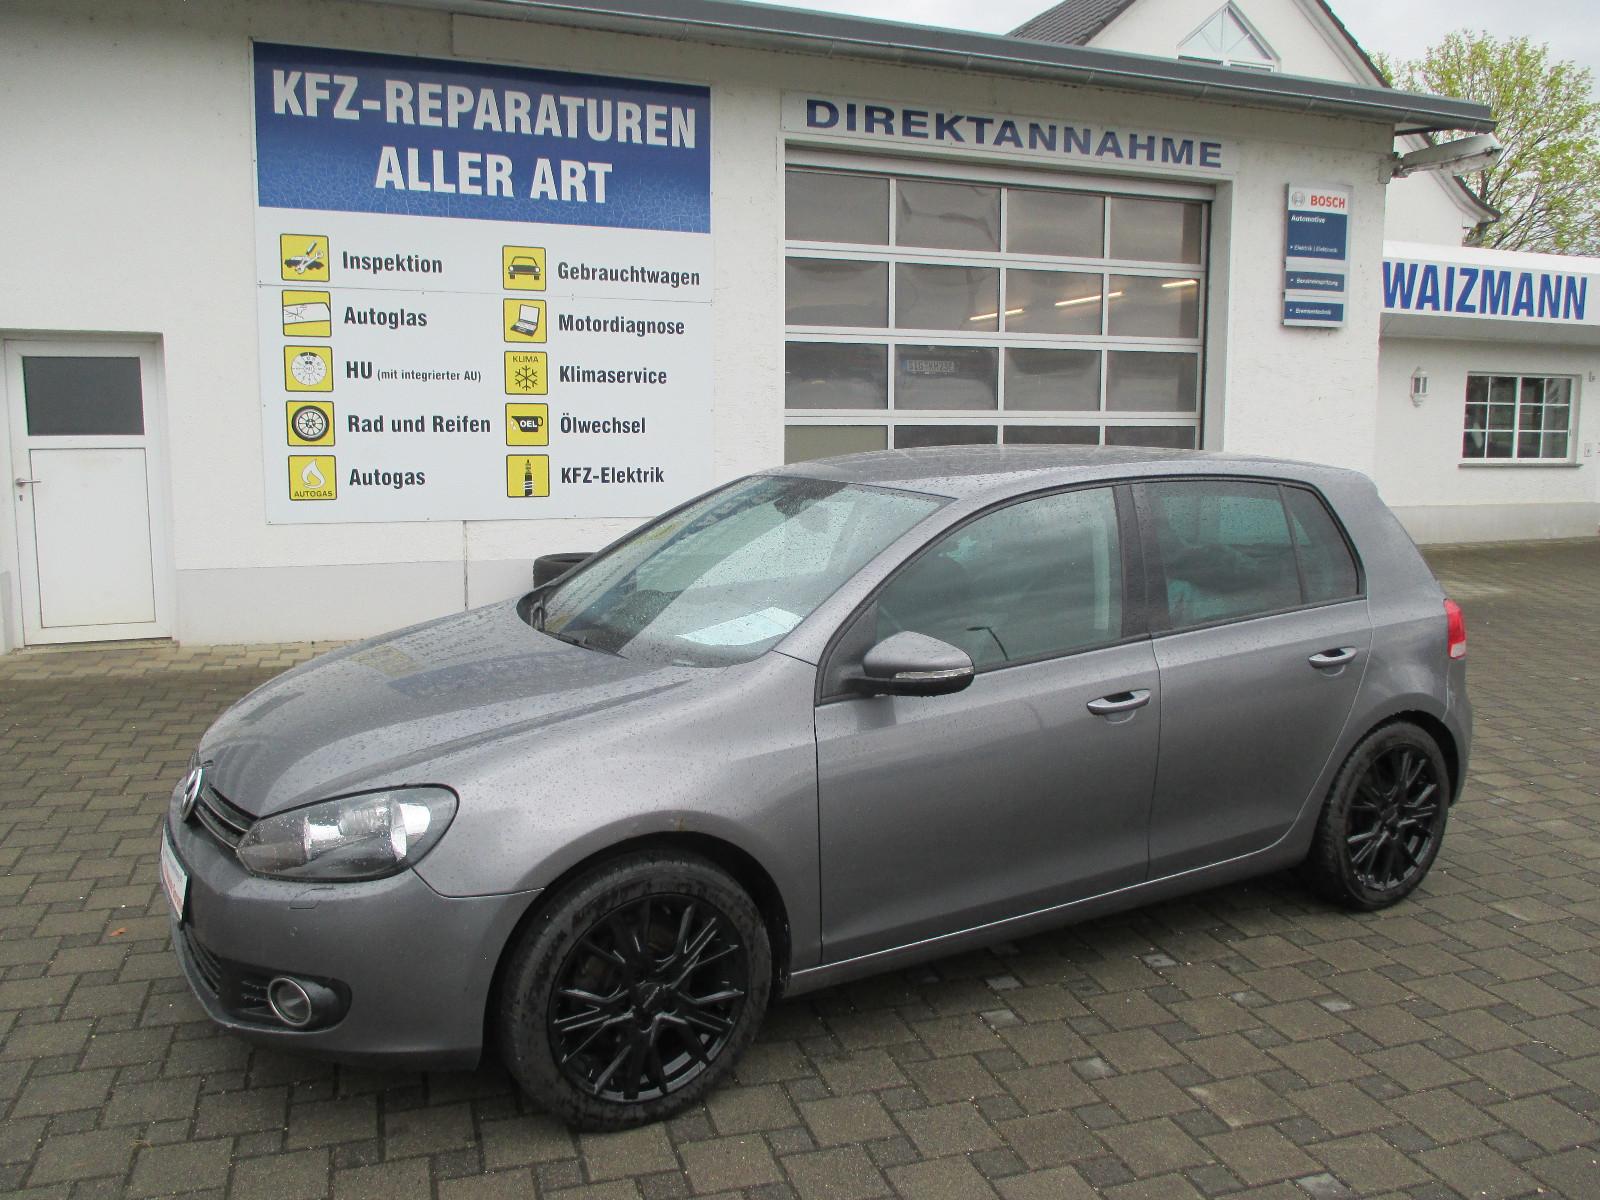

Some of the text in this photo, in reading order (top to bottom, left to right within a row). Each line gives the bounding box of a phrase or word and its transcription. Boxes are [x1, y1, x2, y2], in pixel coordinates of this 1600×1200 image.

[273, 69, 696, 149] KFZ-REPARATUREN
[807, 99, 1222, 168] DIREKTANNAHME
[375, 146, 613, 204] ALLER ART
[1310, 194, 1346, 209] BOSCH
[1290, 214, 1326, 224] Automotive
[342, 251, 443, 274] Inspektion
[557, 261, 700, 288] Gebrauchtwagen
[1382, 261, 1588, 321] WAIZMANN
[343, 306, 428, 330] Autoglas
[558, 313, 685, 337] Motordiagnose
[512, 355, 539, 363] KLIMA
[346, 360, 482, 383] HU (mit integrierter AU)
[559, 365, 667, 384] Klimaservice
[347, 414, 491, 433] Rad und Reifen
[519, 420, 538, 429] OEL
[560, 412, 646, 434] Ölwechsel
[349, 468, 426, 490] Autogas
[561, 466, 665, 484] KFZ-Elektrik
[294, 490, 333, 498] AUTOGAS
